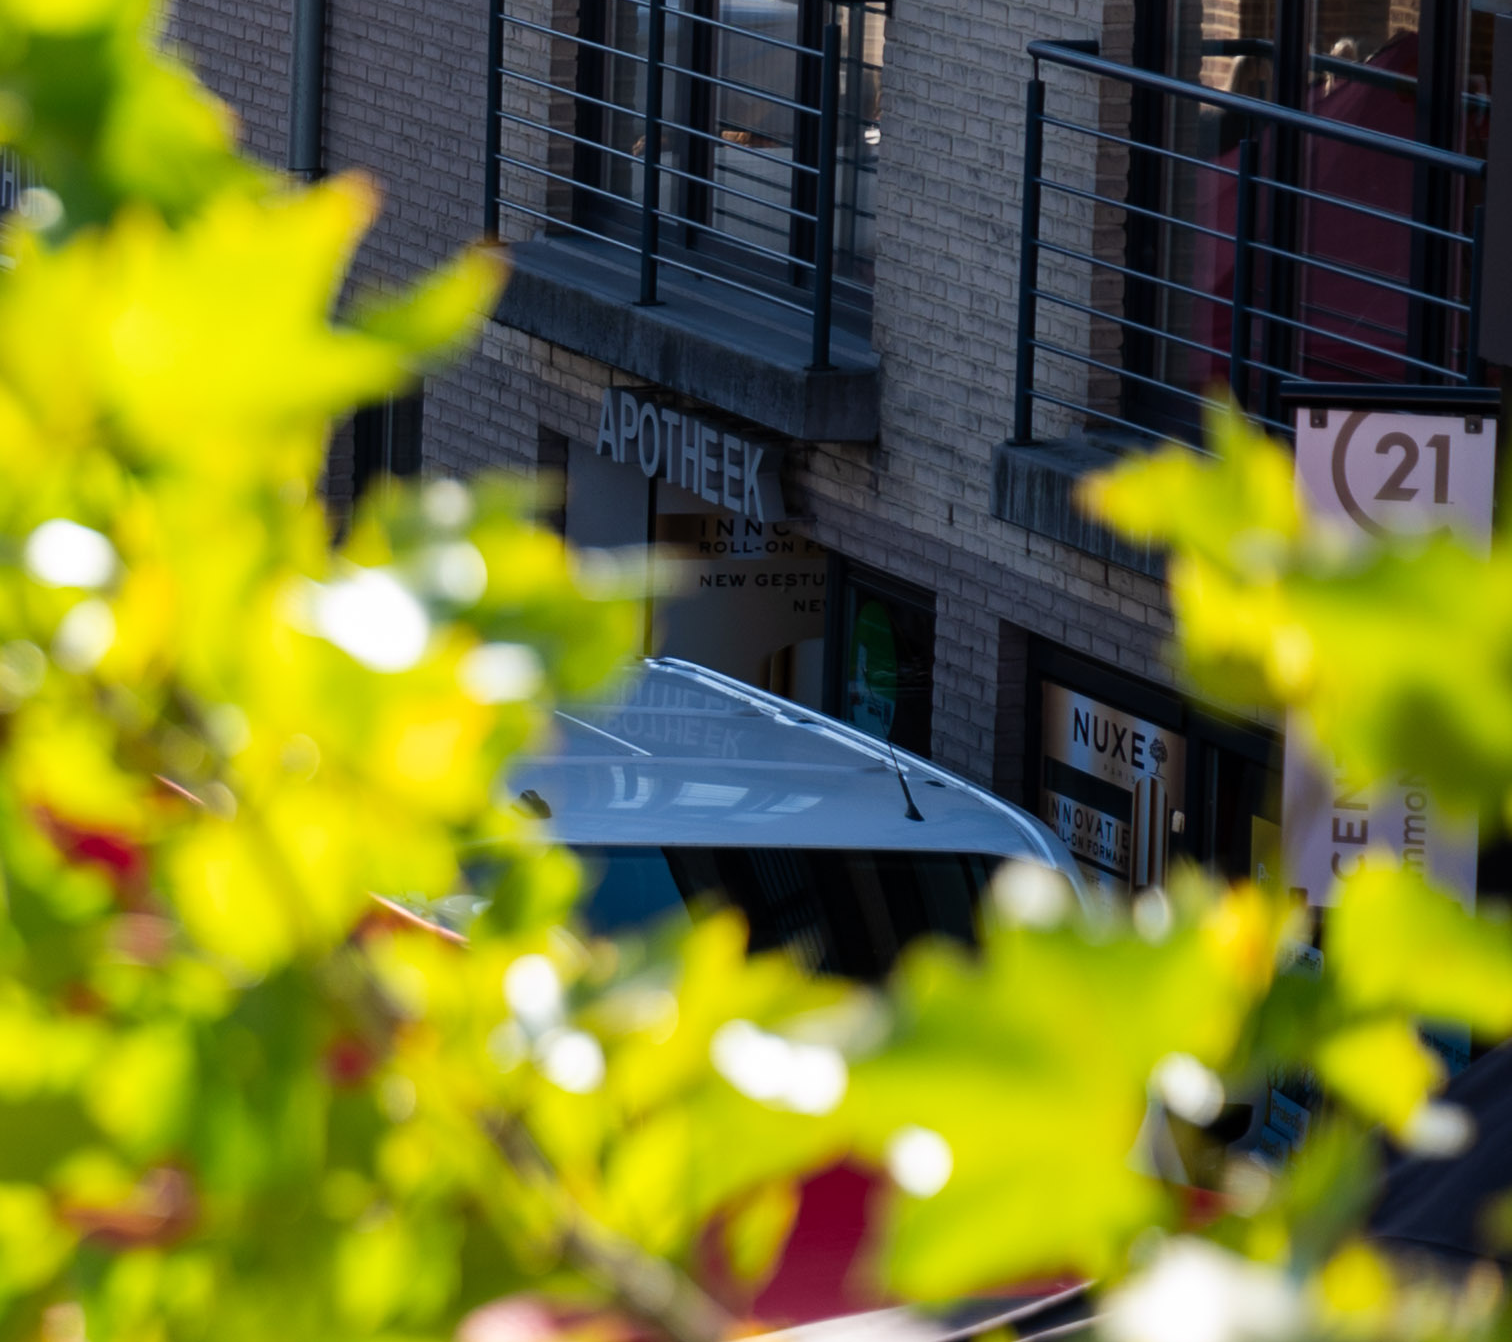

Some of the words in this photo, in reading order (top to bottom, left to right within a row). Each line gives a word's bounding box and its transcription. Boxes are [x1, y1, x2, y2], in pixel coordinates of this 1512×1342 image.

[596, 387, 764, 524] APOTHEEK
[699, 540, 794, 555] ROLL-ON
[700, 573, 747, 588] NEW
[1073, 707, 1146, 770] NUXE
[1047, 796, 1130, 850] INNOVATIE
